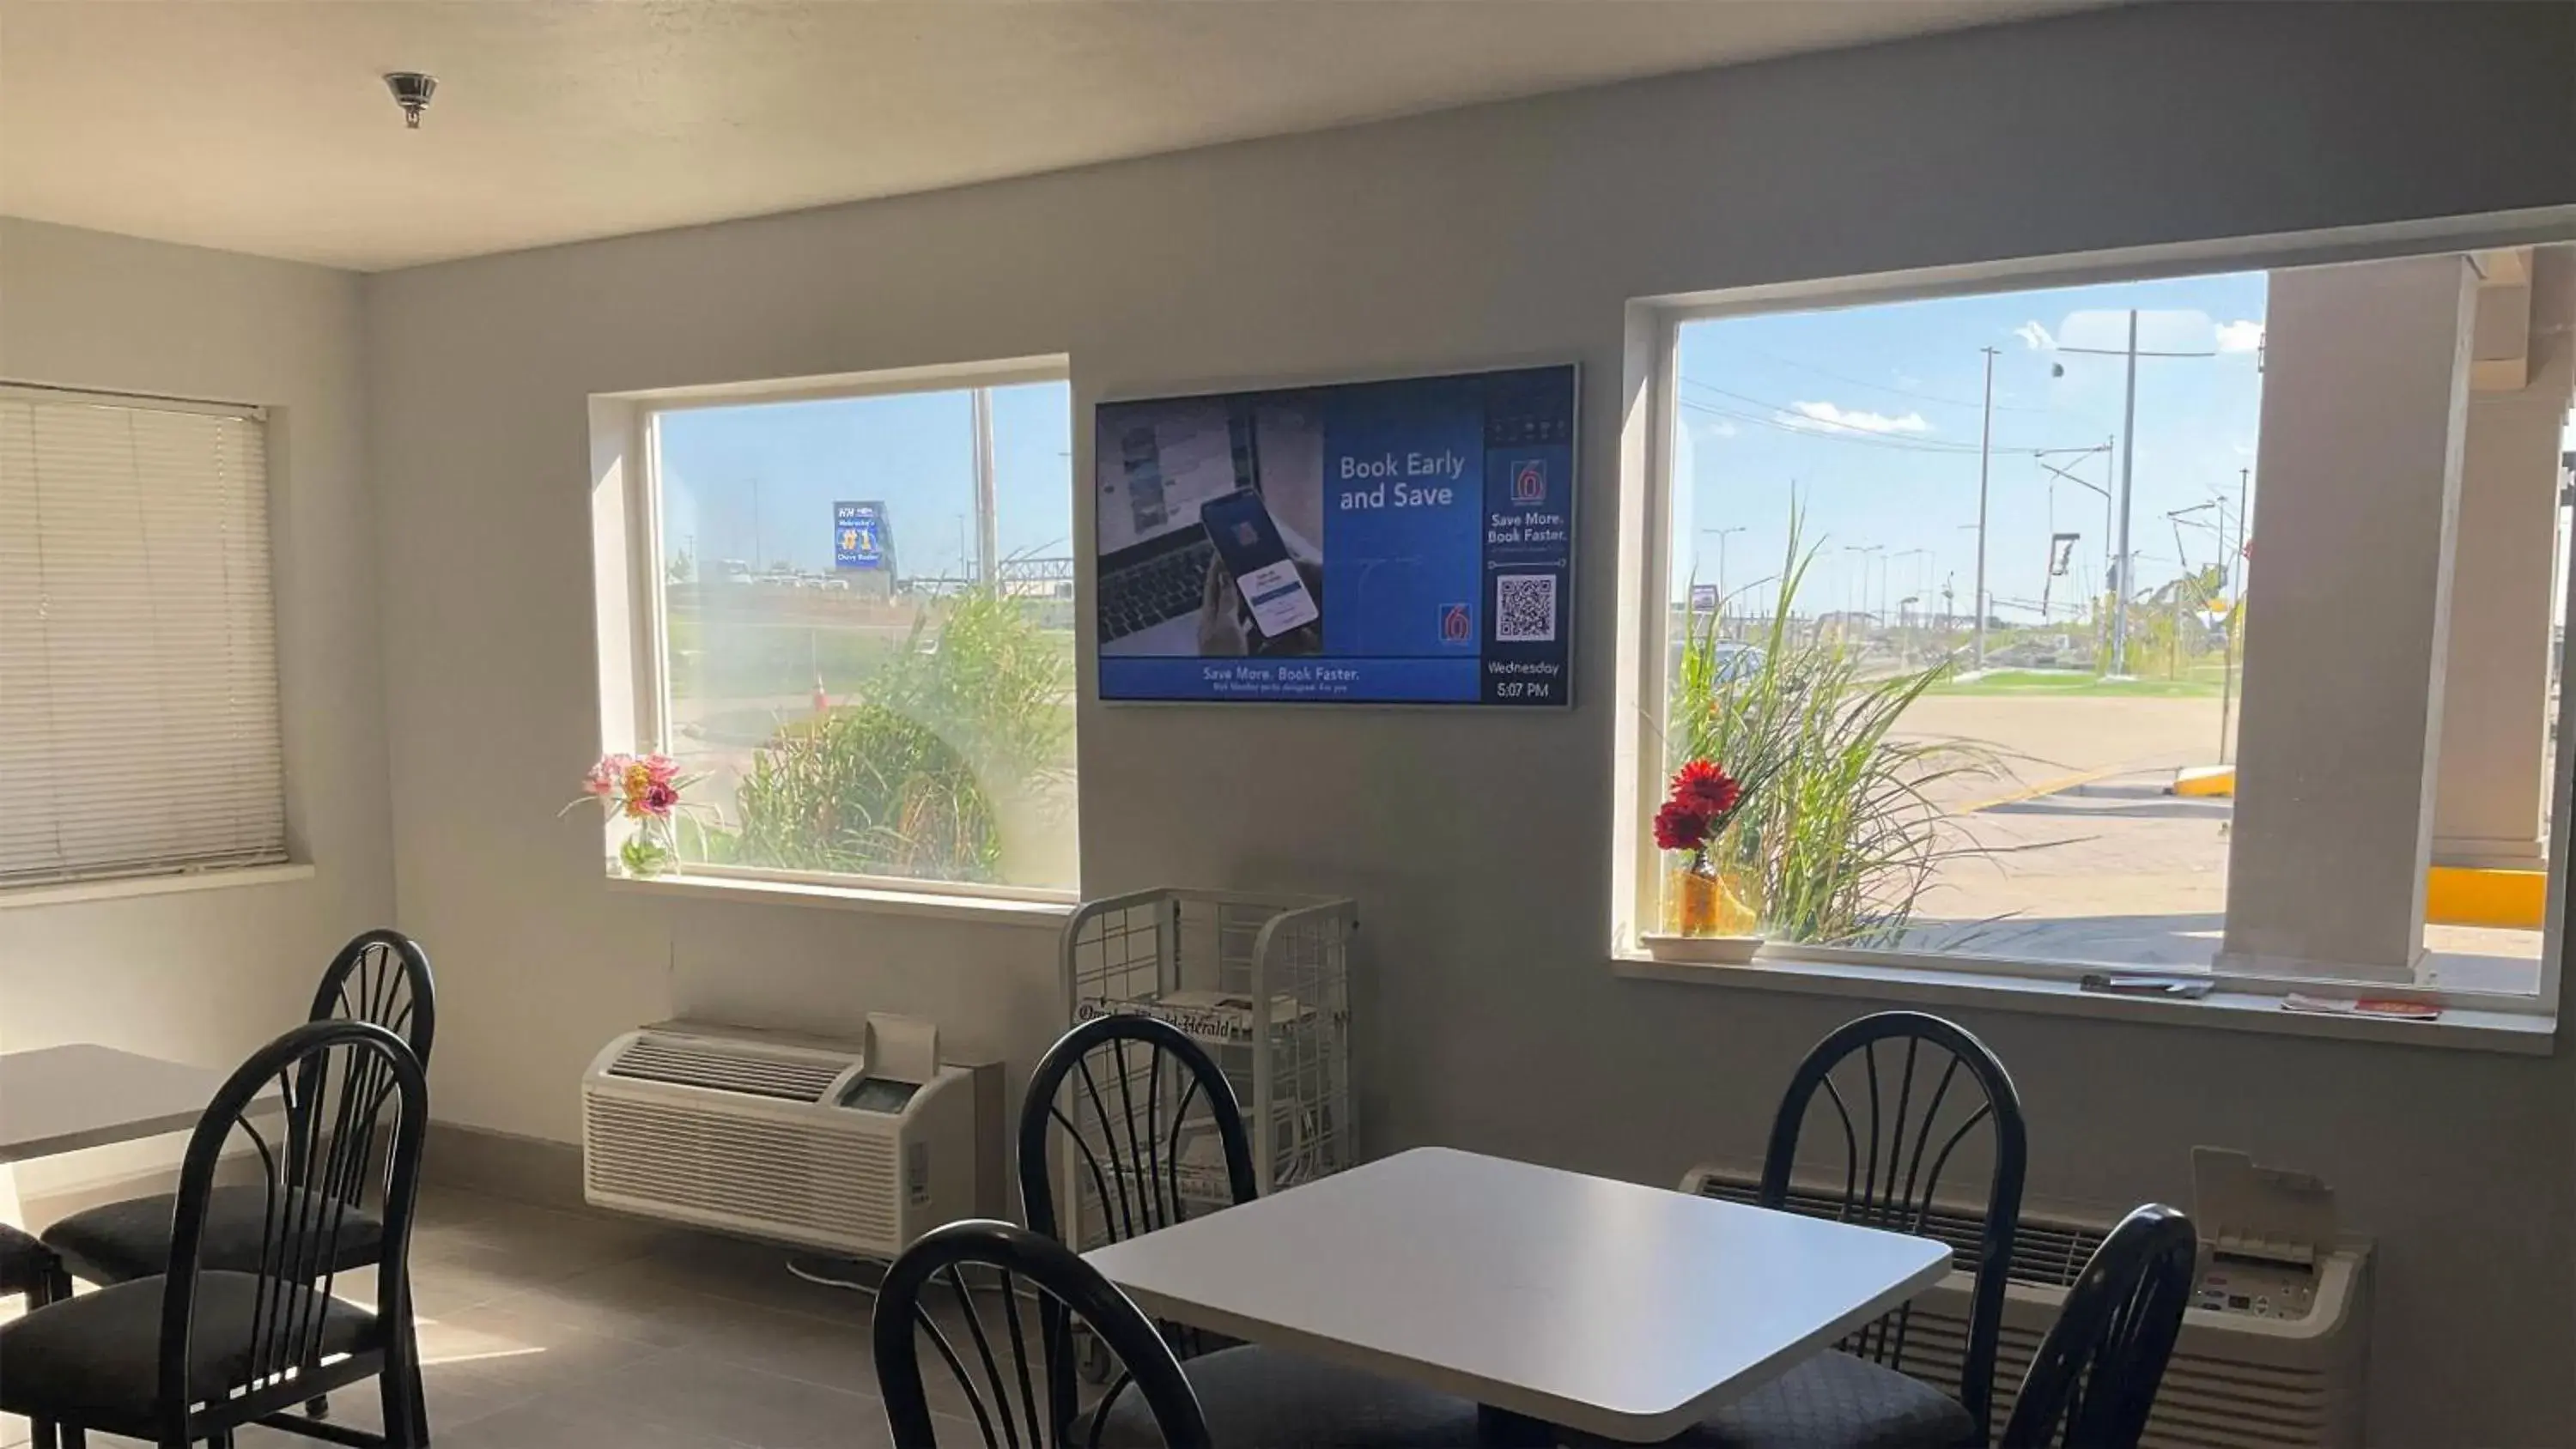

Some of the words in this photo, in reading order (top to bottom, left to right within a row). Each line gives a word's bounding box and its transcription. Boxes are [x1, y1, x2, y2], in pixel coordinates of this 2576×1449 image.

[1340, 452, 1399, 479] Book
[1406, 448, 1466, 480] Early
[1340, 482, 1386, 511] and
[1394, 482, 1454, 508] Save
[1492, 513, 1522, 527] Save
[1525, 512, 1564, 525] More.
[1488, 526, 1520, 543] Book
[1524, 528, 1568, 542] Faster.
[1203, 666, 1232, 680] Save
[1279, 666, 1312, 681] Book
[1315, 667, 1360, 681] Faster.
[1488, 661, 1560, 677] Wednesday
[1497, 683, 1522, 698] 5:07
[1527, 683, 1550, 697] PM
